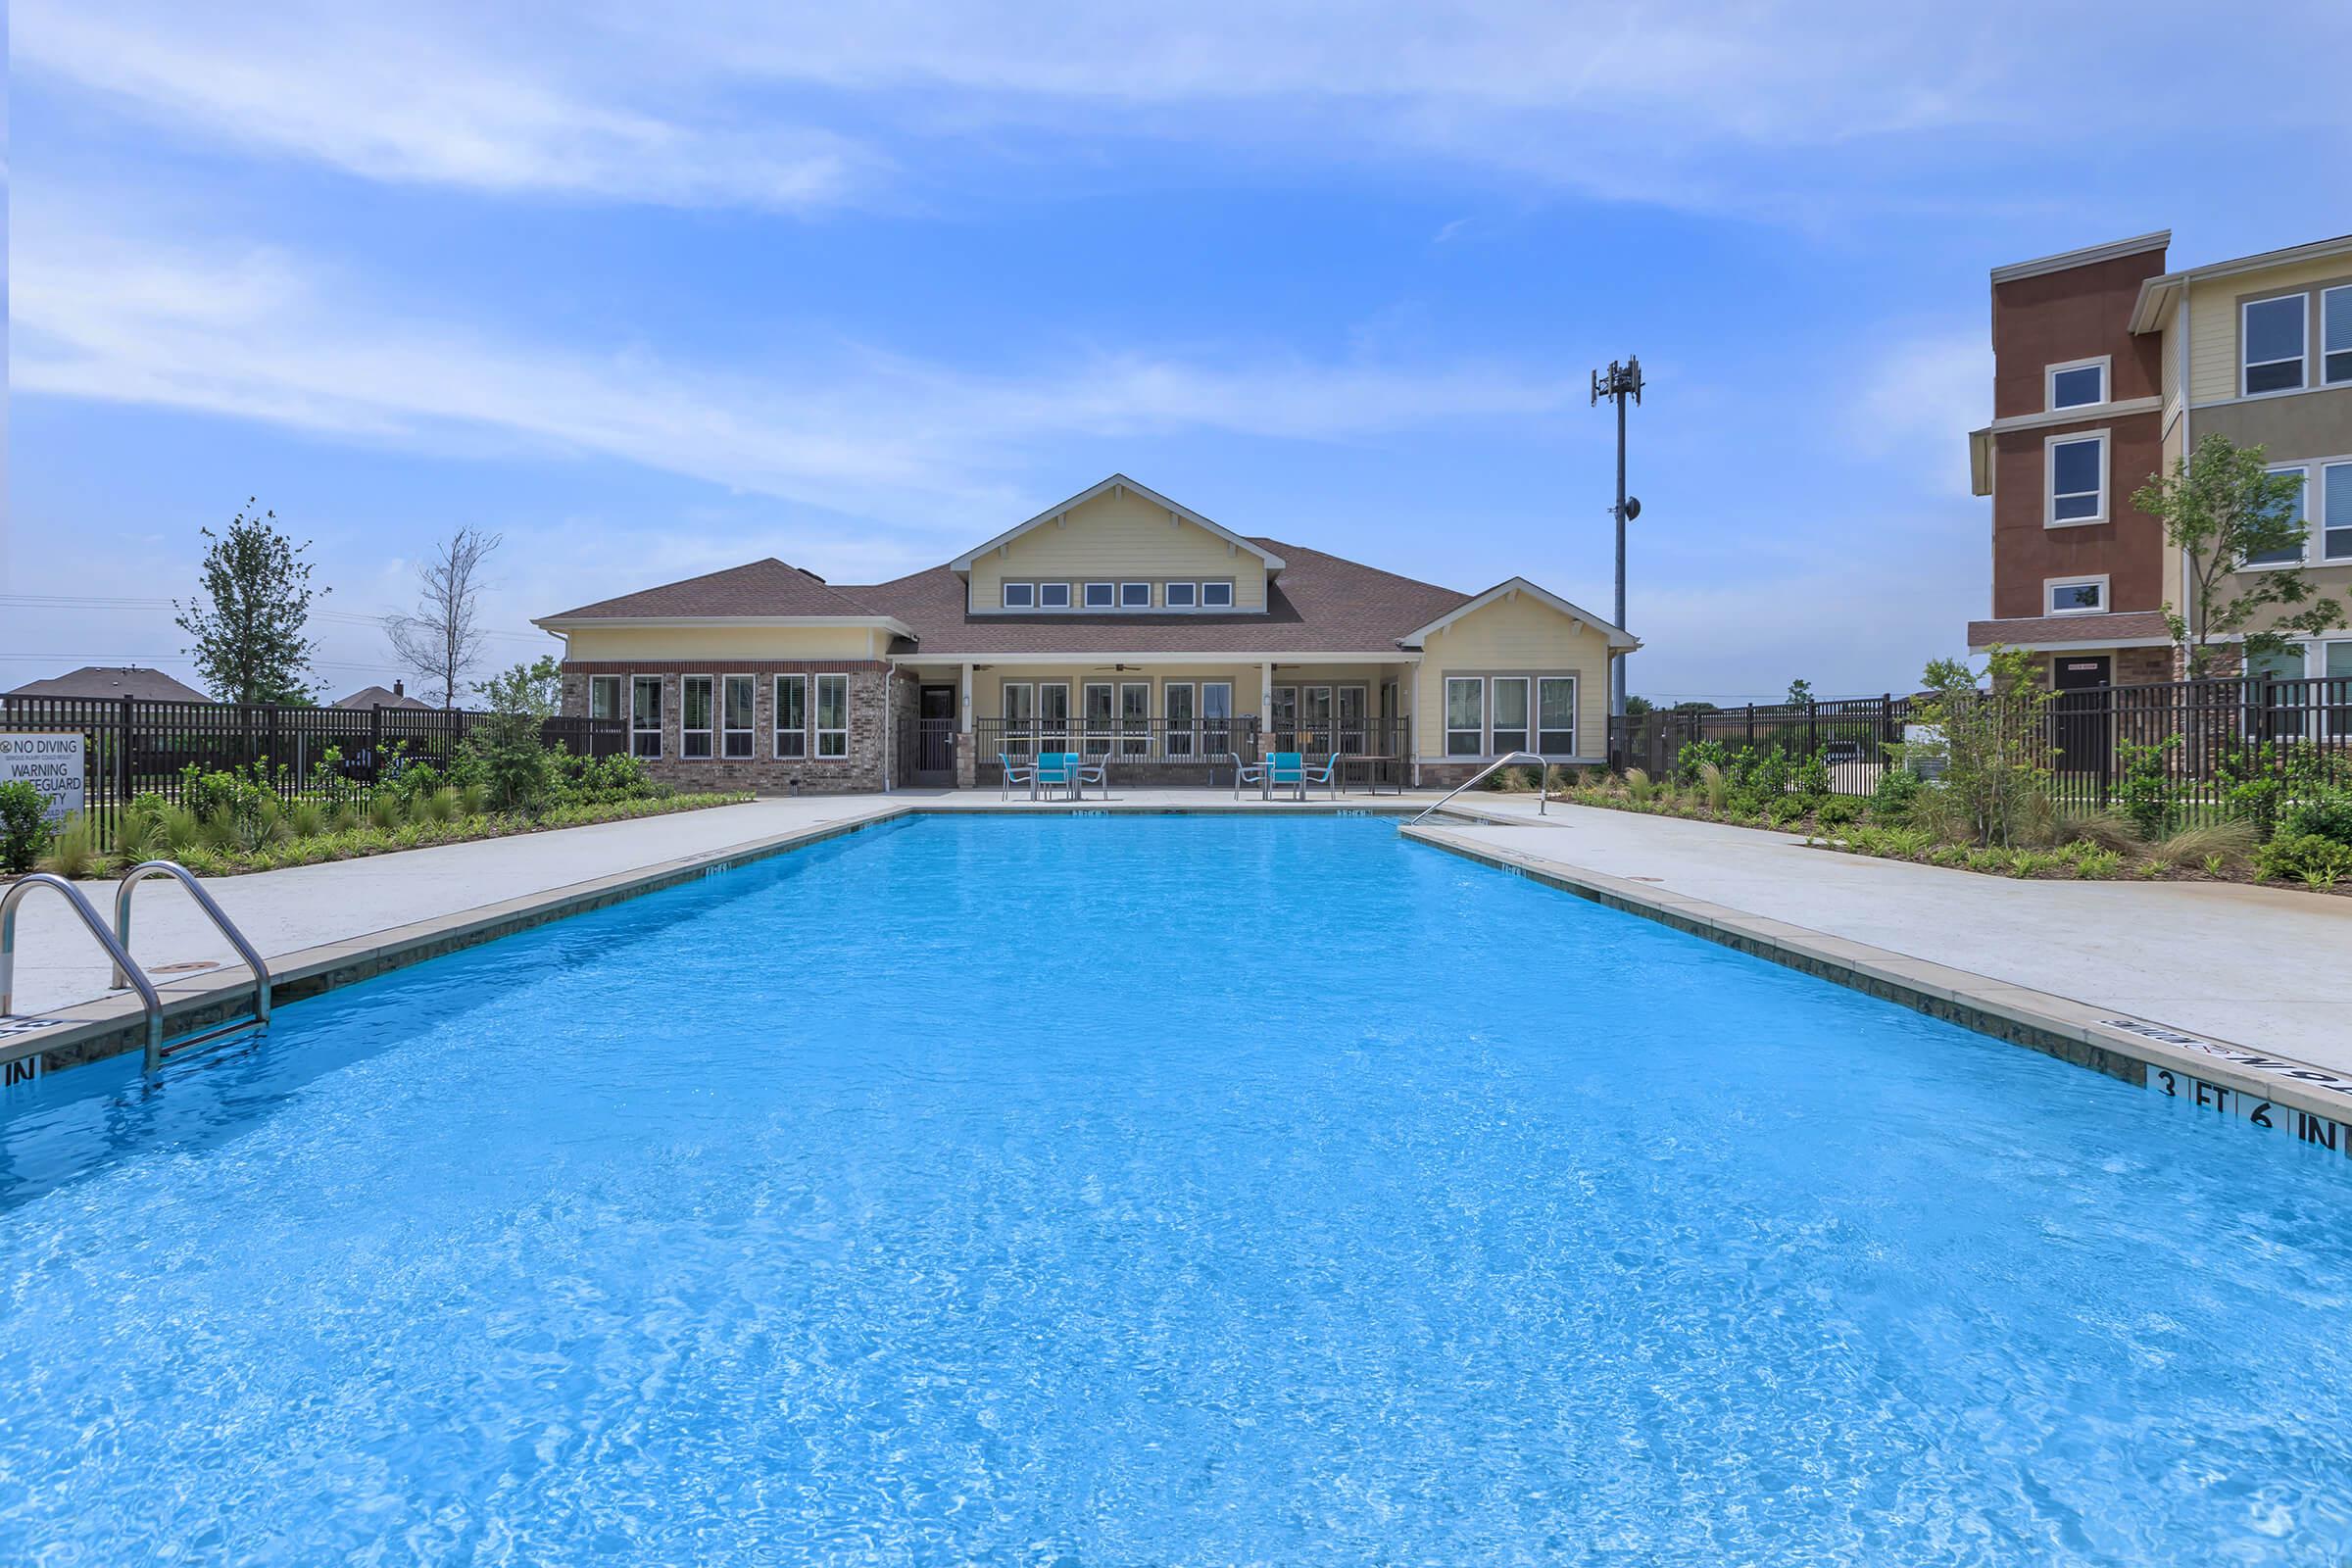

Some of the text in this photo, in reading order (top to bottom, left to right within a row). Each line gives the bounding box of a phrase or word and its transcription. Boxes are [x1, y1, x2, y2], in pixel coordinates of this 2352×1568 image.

[14, 740, 77, 754] NO DIVING
[12, 763, 68, 777] WARNING
[20, 777, 81, 792] EGUARD
[6, 1057, 35, 1087] IN
[2158, 1070, 2336, 1151] 3 FT 6 IN
